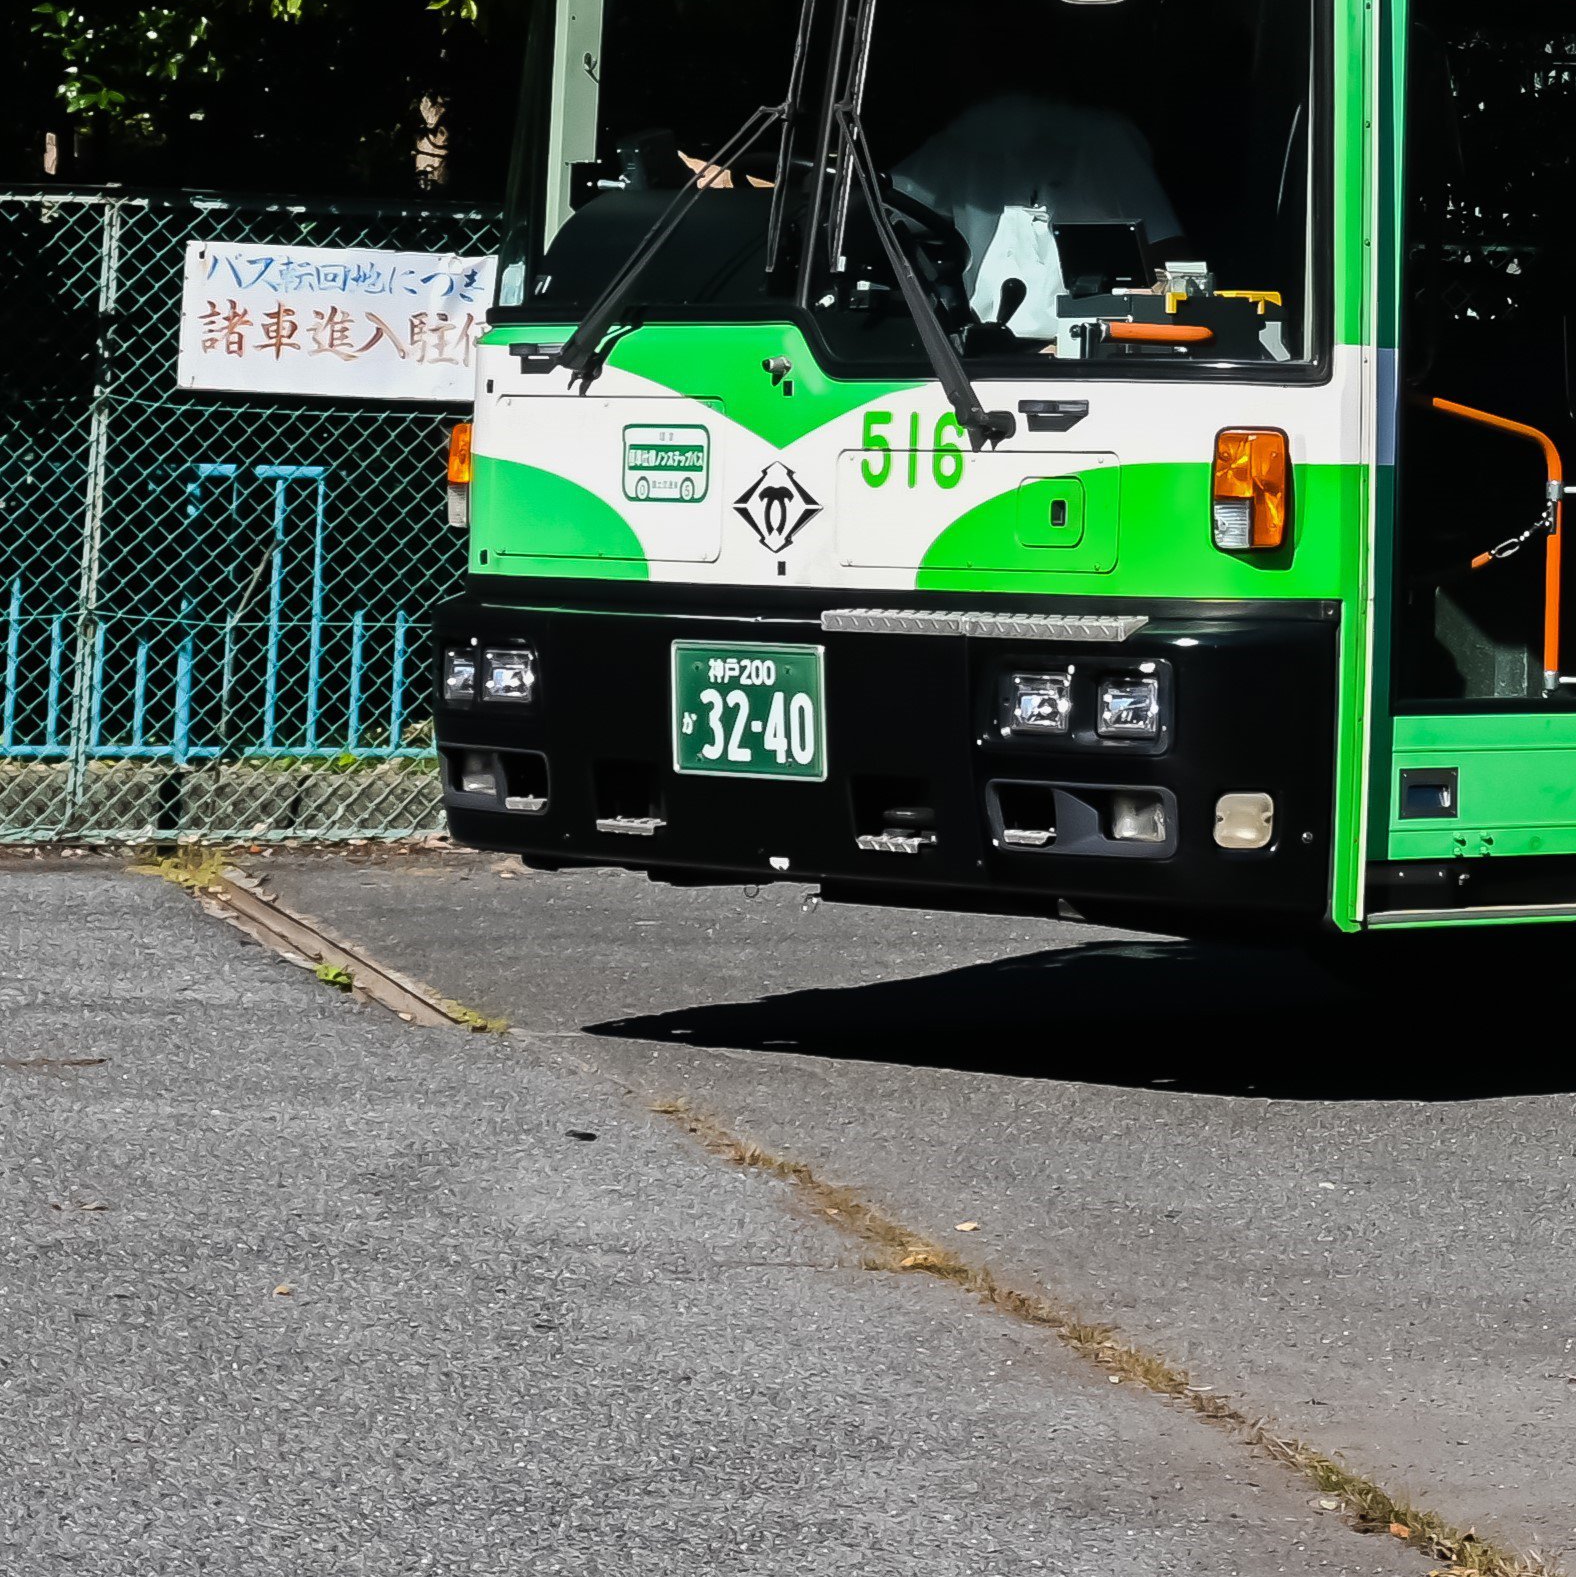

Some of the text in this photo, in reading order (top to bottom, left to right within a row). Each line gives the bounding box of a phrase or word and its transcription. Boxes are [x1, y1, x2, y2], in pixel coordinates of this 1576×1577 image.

[206, 253, 485, 303] バス転回地につき
[861, 410, 964, 490] 516
[699, 688, 815, 765] 32-40
